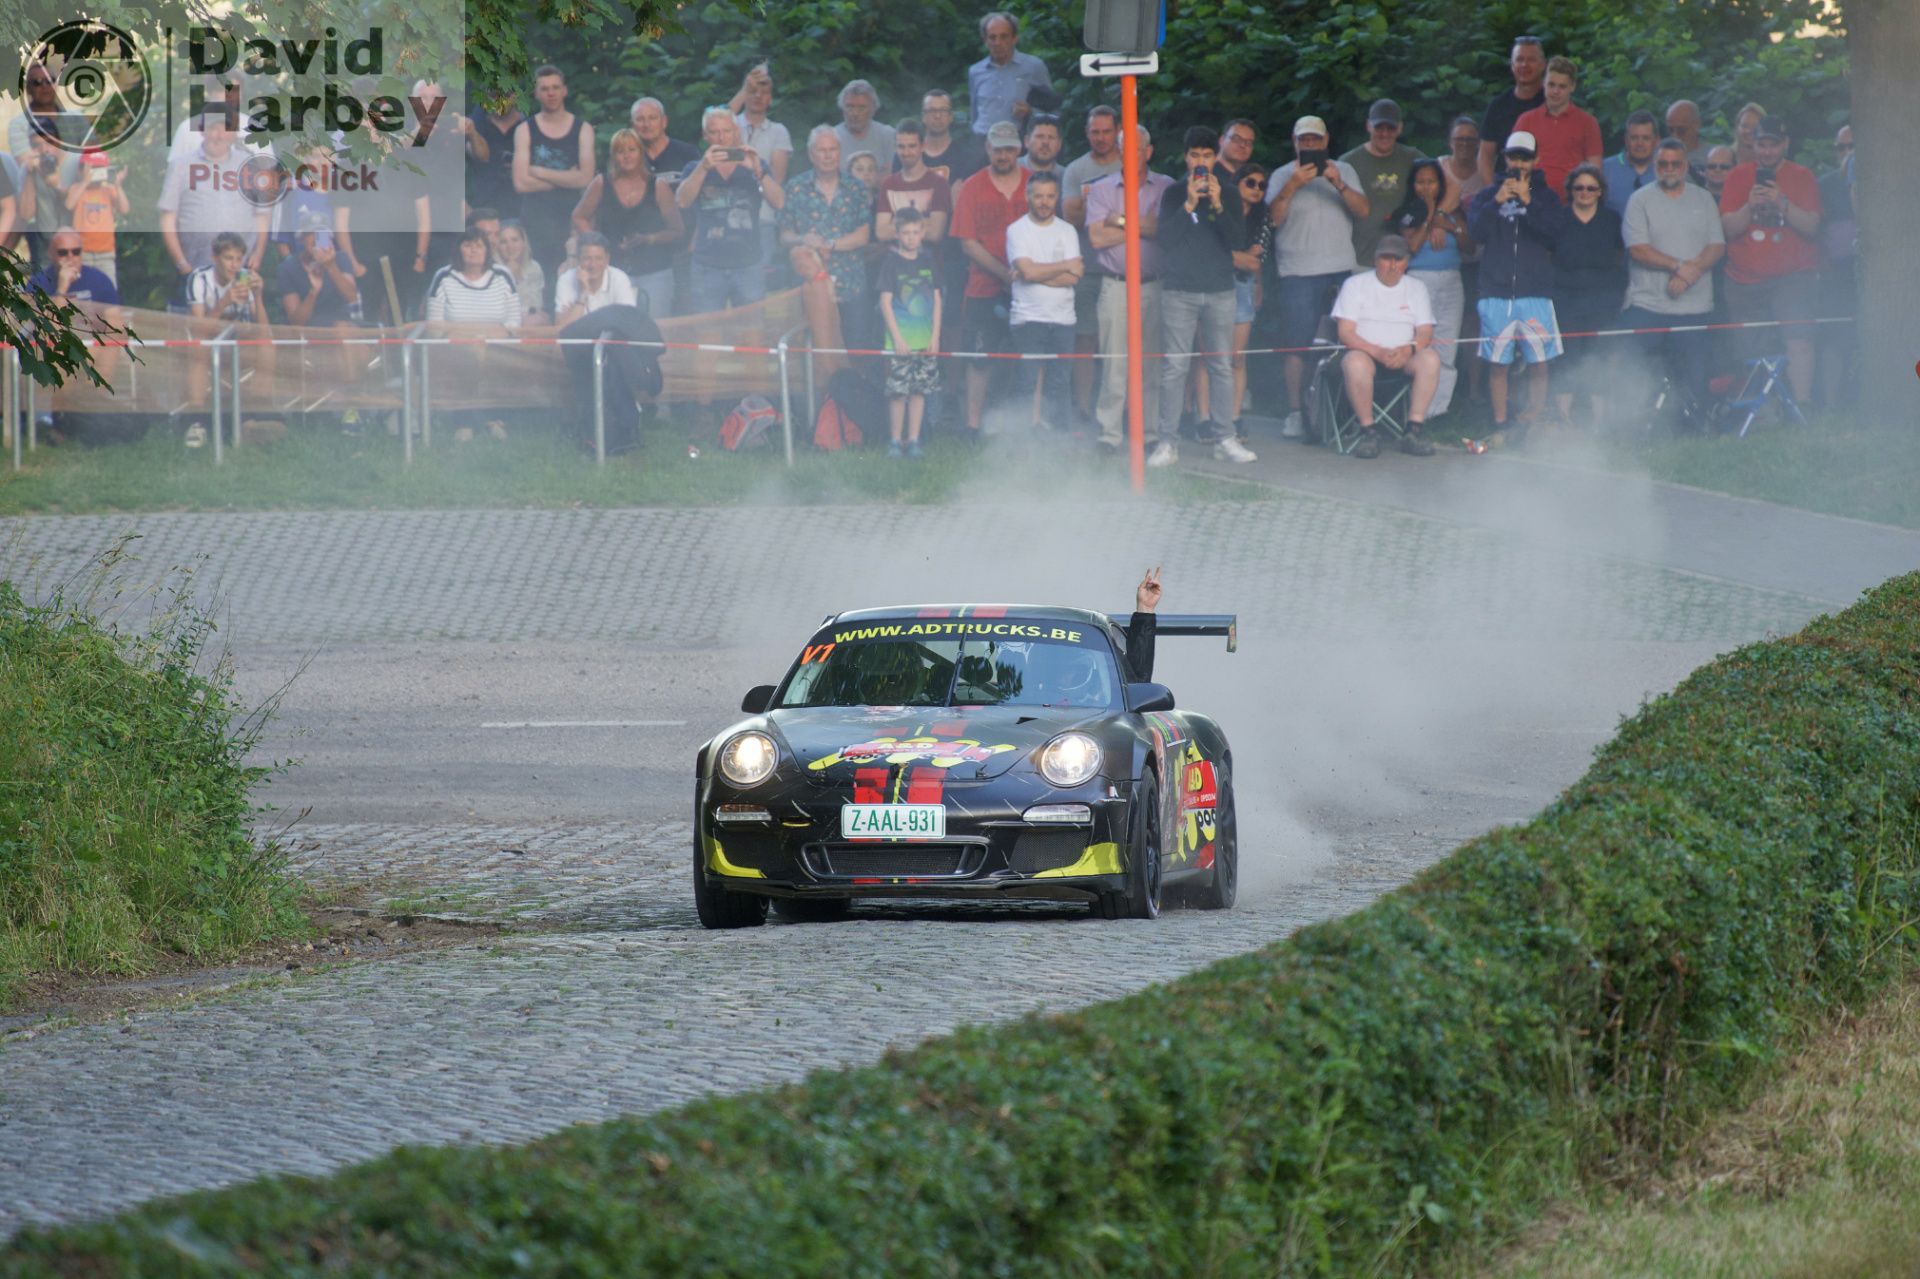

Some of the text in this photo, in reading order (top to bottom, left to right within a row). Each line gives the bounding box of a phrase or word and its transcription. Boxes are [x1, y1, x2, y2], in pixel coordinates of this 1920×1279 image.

[834, 622, 1082, 644] WWW.ADTRUCKS.BE
[800, 642, 836, 665] V1
[851, 809, 936, 832] Z-AAL-931
